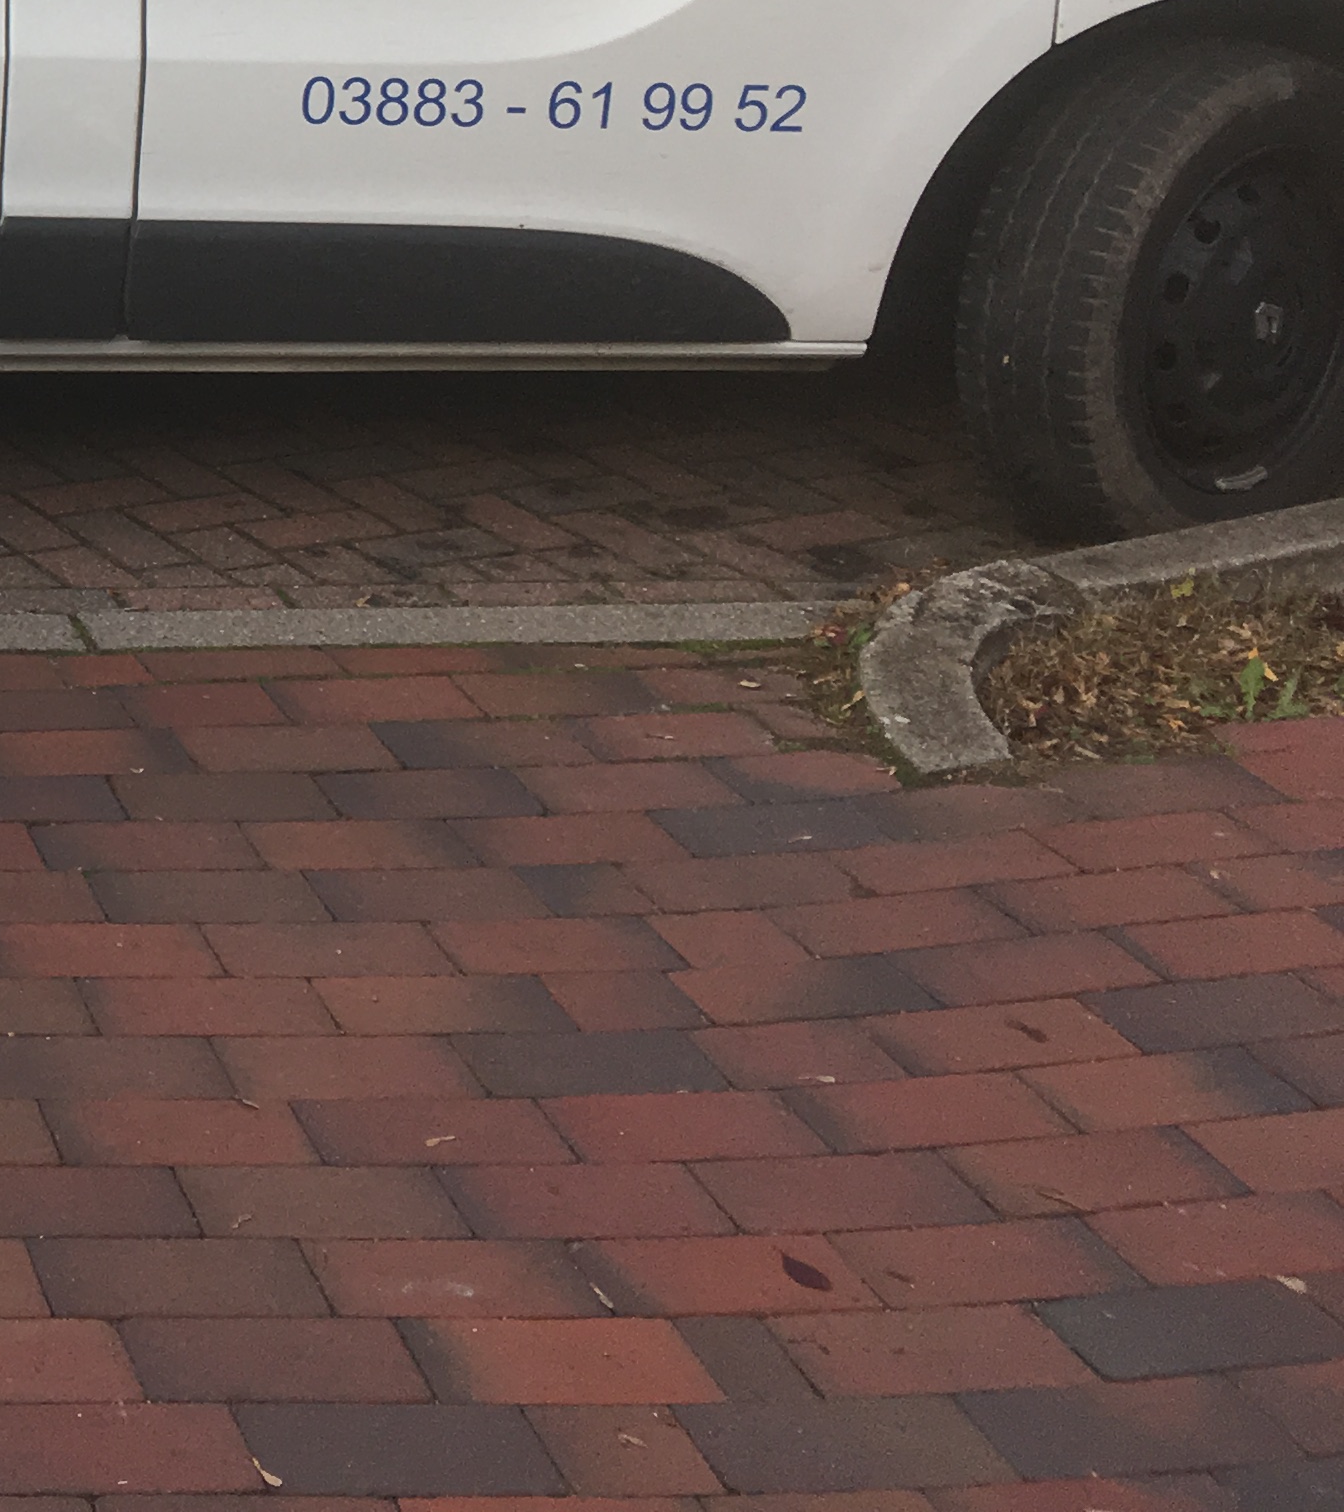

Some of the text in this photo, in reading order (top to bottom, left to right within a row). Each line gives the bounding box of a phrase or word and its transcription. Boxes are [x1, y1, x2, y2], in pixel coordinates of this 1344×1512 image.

[302, 75, 485, 128] 03883
[548, 80, 614, 130] 61
[642, 82, 714, 131] 99
[735, 84, 808, 134] 52
